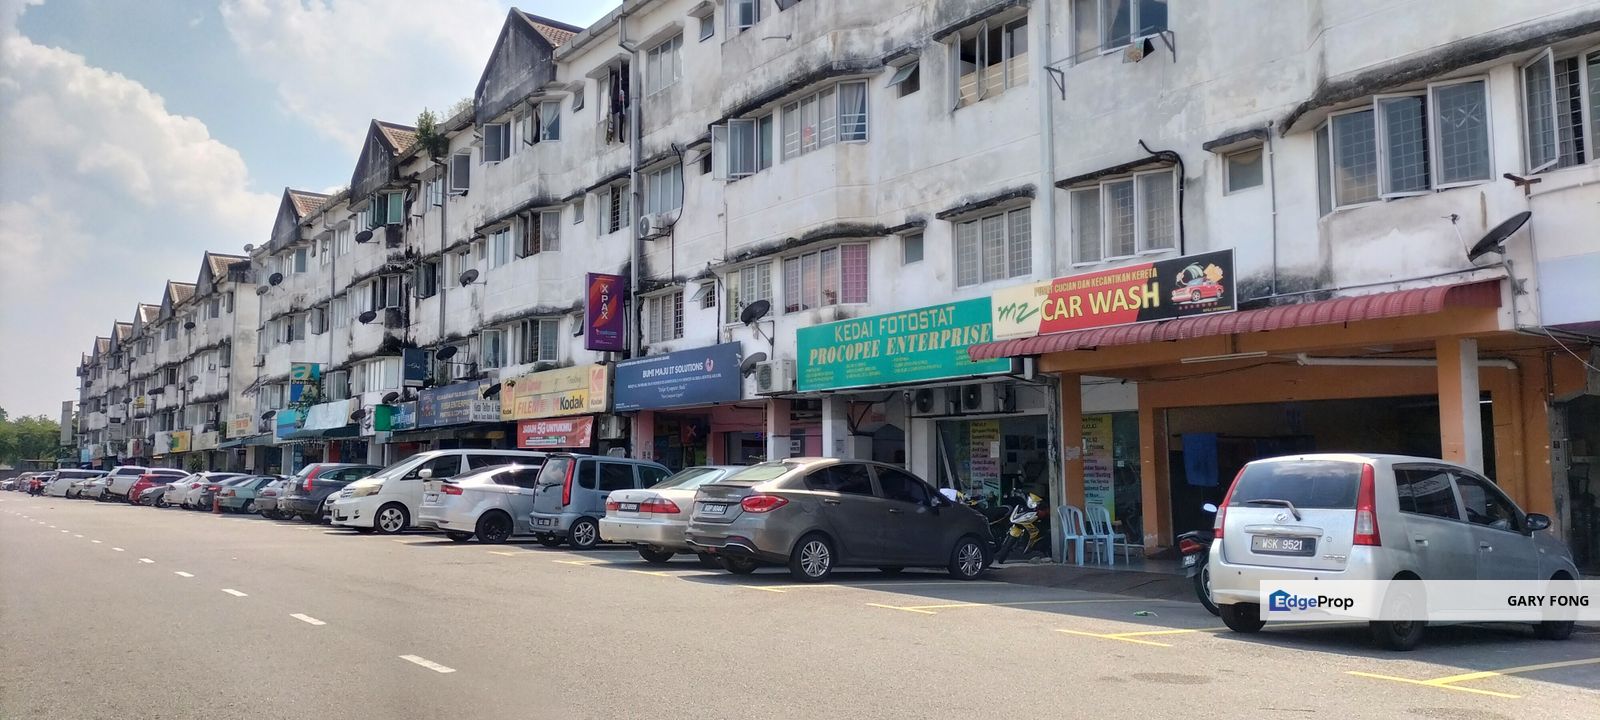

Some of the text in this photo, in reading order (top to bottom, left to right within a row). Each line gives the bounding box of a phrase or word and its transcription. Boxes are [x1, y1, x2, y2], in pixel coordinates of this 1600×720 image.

[1055, 280, 1077, 293] CUCIAN
[1078, 278, 1091, 290] DAN
[1091, 272, 1131, 287] KECANTIKAN
[1131, 267, 1157, 281] KERETA
[601, 283, 609, 320] XPAX
[1040, 282, 1160, 321] CAR WASH
[834, 306, 956, 342] KEDAI FOTOSTAT
[808, 339, 880, 366] PROCOPEE
[886, 323, 992, 356] ENTERPRISE
[642, 362, 703, 378] BUMI MAJU IT SOLUTIONS
[560, 394, 584, 411] Kodak
[1261, 538, 1303, 550] WSK 9521
